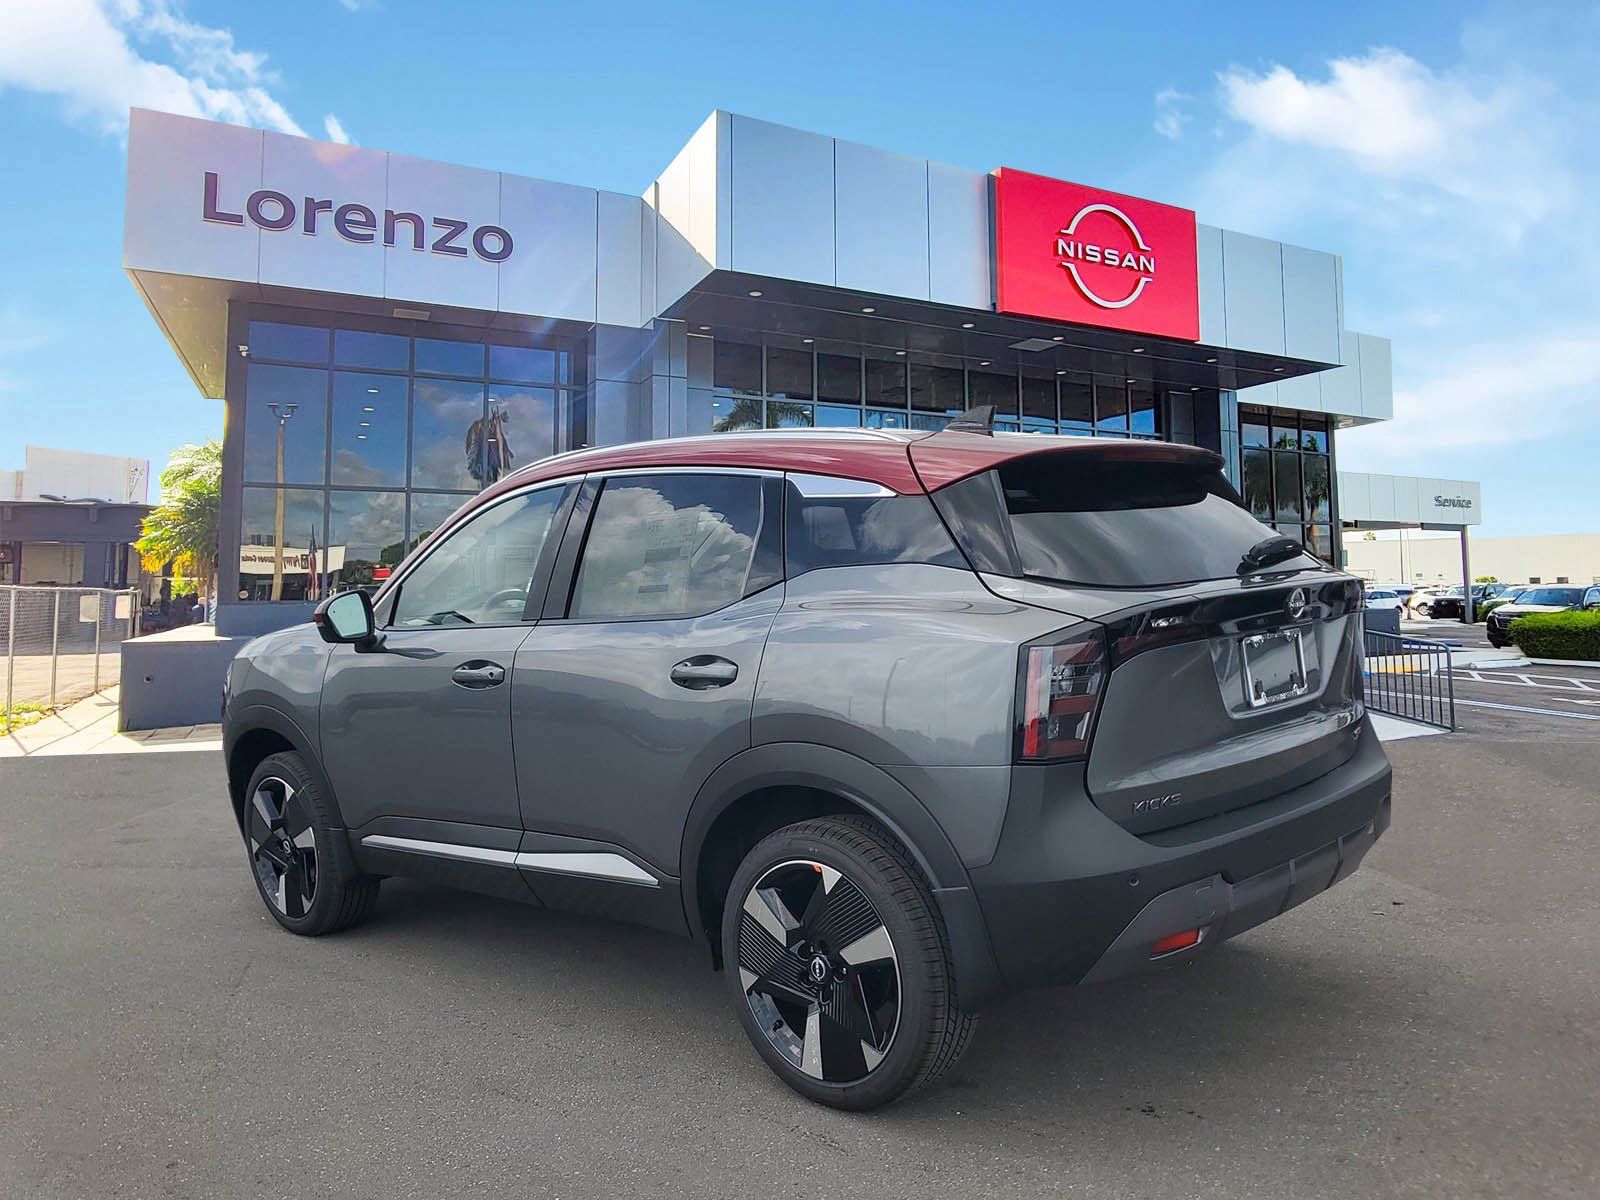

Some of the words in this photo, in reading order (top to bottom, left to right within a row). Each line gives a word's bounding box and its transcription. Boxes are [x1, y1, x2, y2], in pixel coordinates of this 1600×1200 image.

[203, 171, 514, 263] Lorenzo
[1057, 238, 1155, 273] NISSAN
[1434, 495, 1472, 509] Service
[1131, 793, 1182, 815] KICKS
